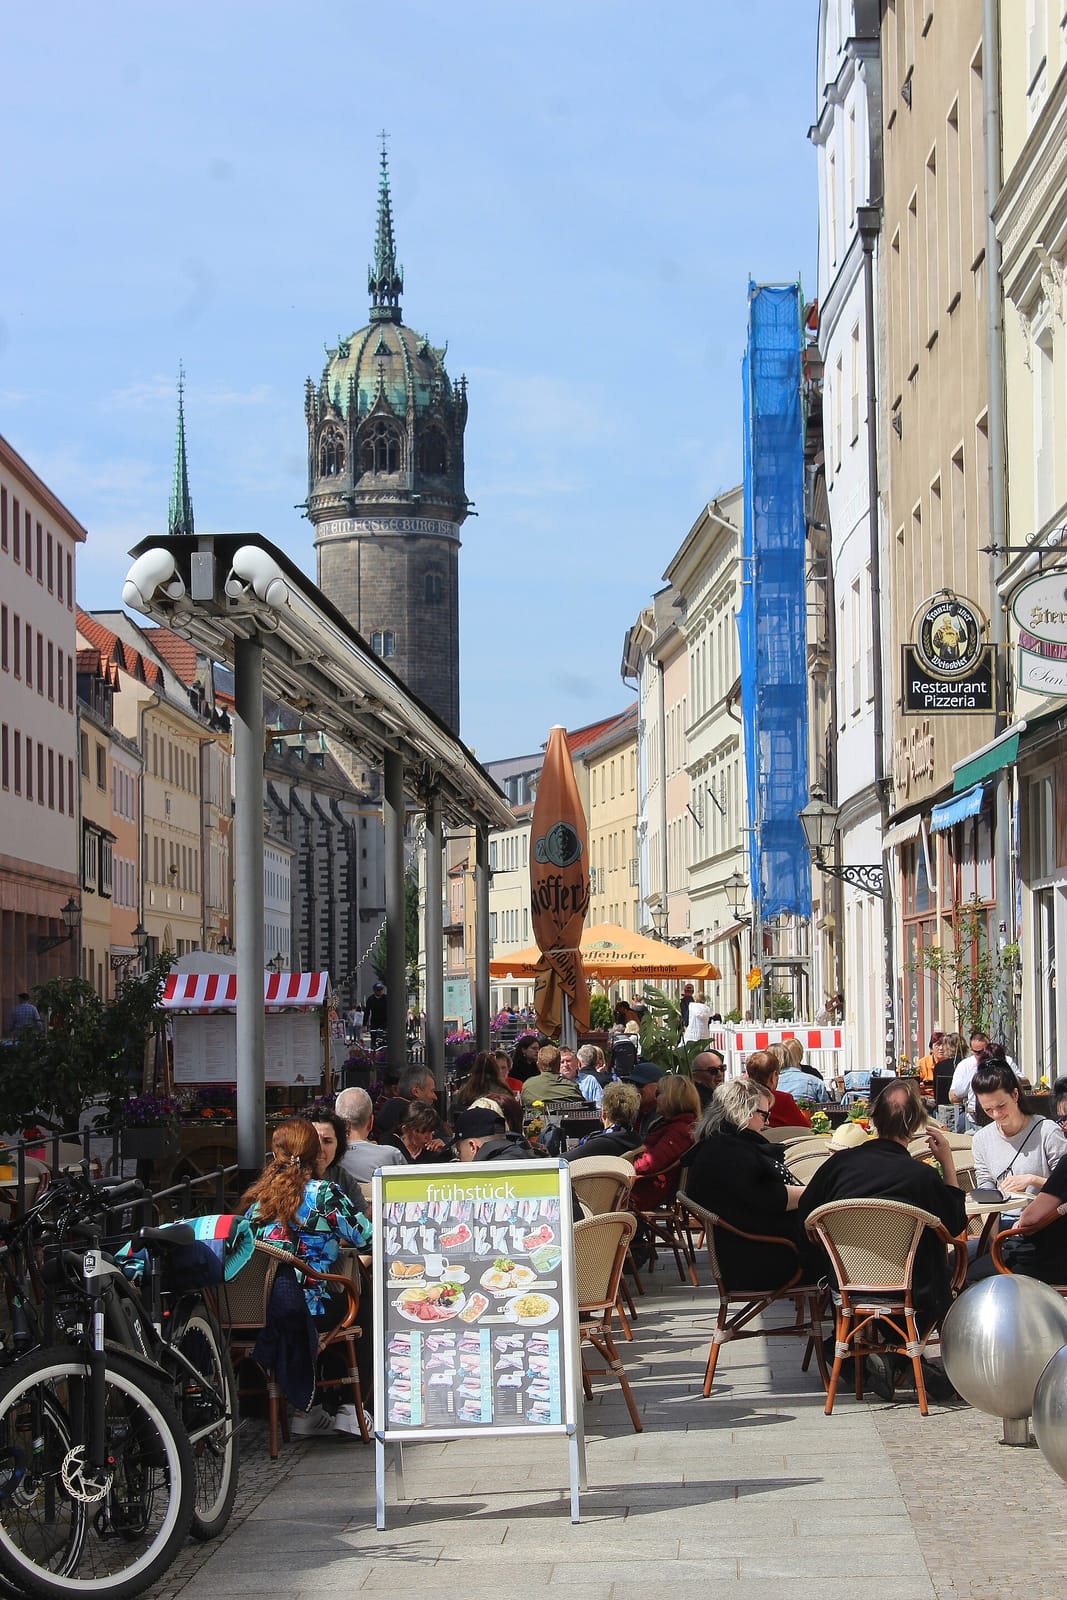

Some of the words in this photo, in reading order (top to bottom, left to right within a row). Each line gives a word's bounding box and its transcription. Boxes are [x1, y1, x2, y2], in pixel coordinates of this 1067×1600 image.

[912, 681, 987, 694] Restaurant
[924, 694, 976, 707] Pizzeria
[426, 1181, 516, 1201] frühstück
